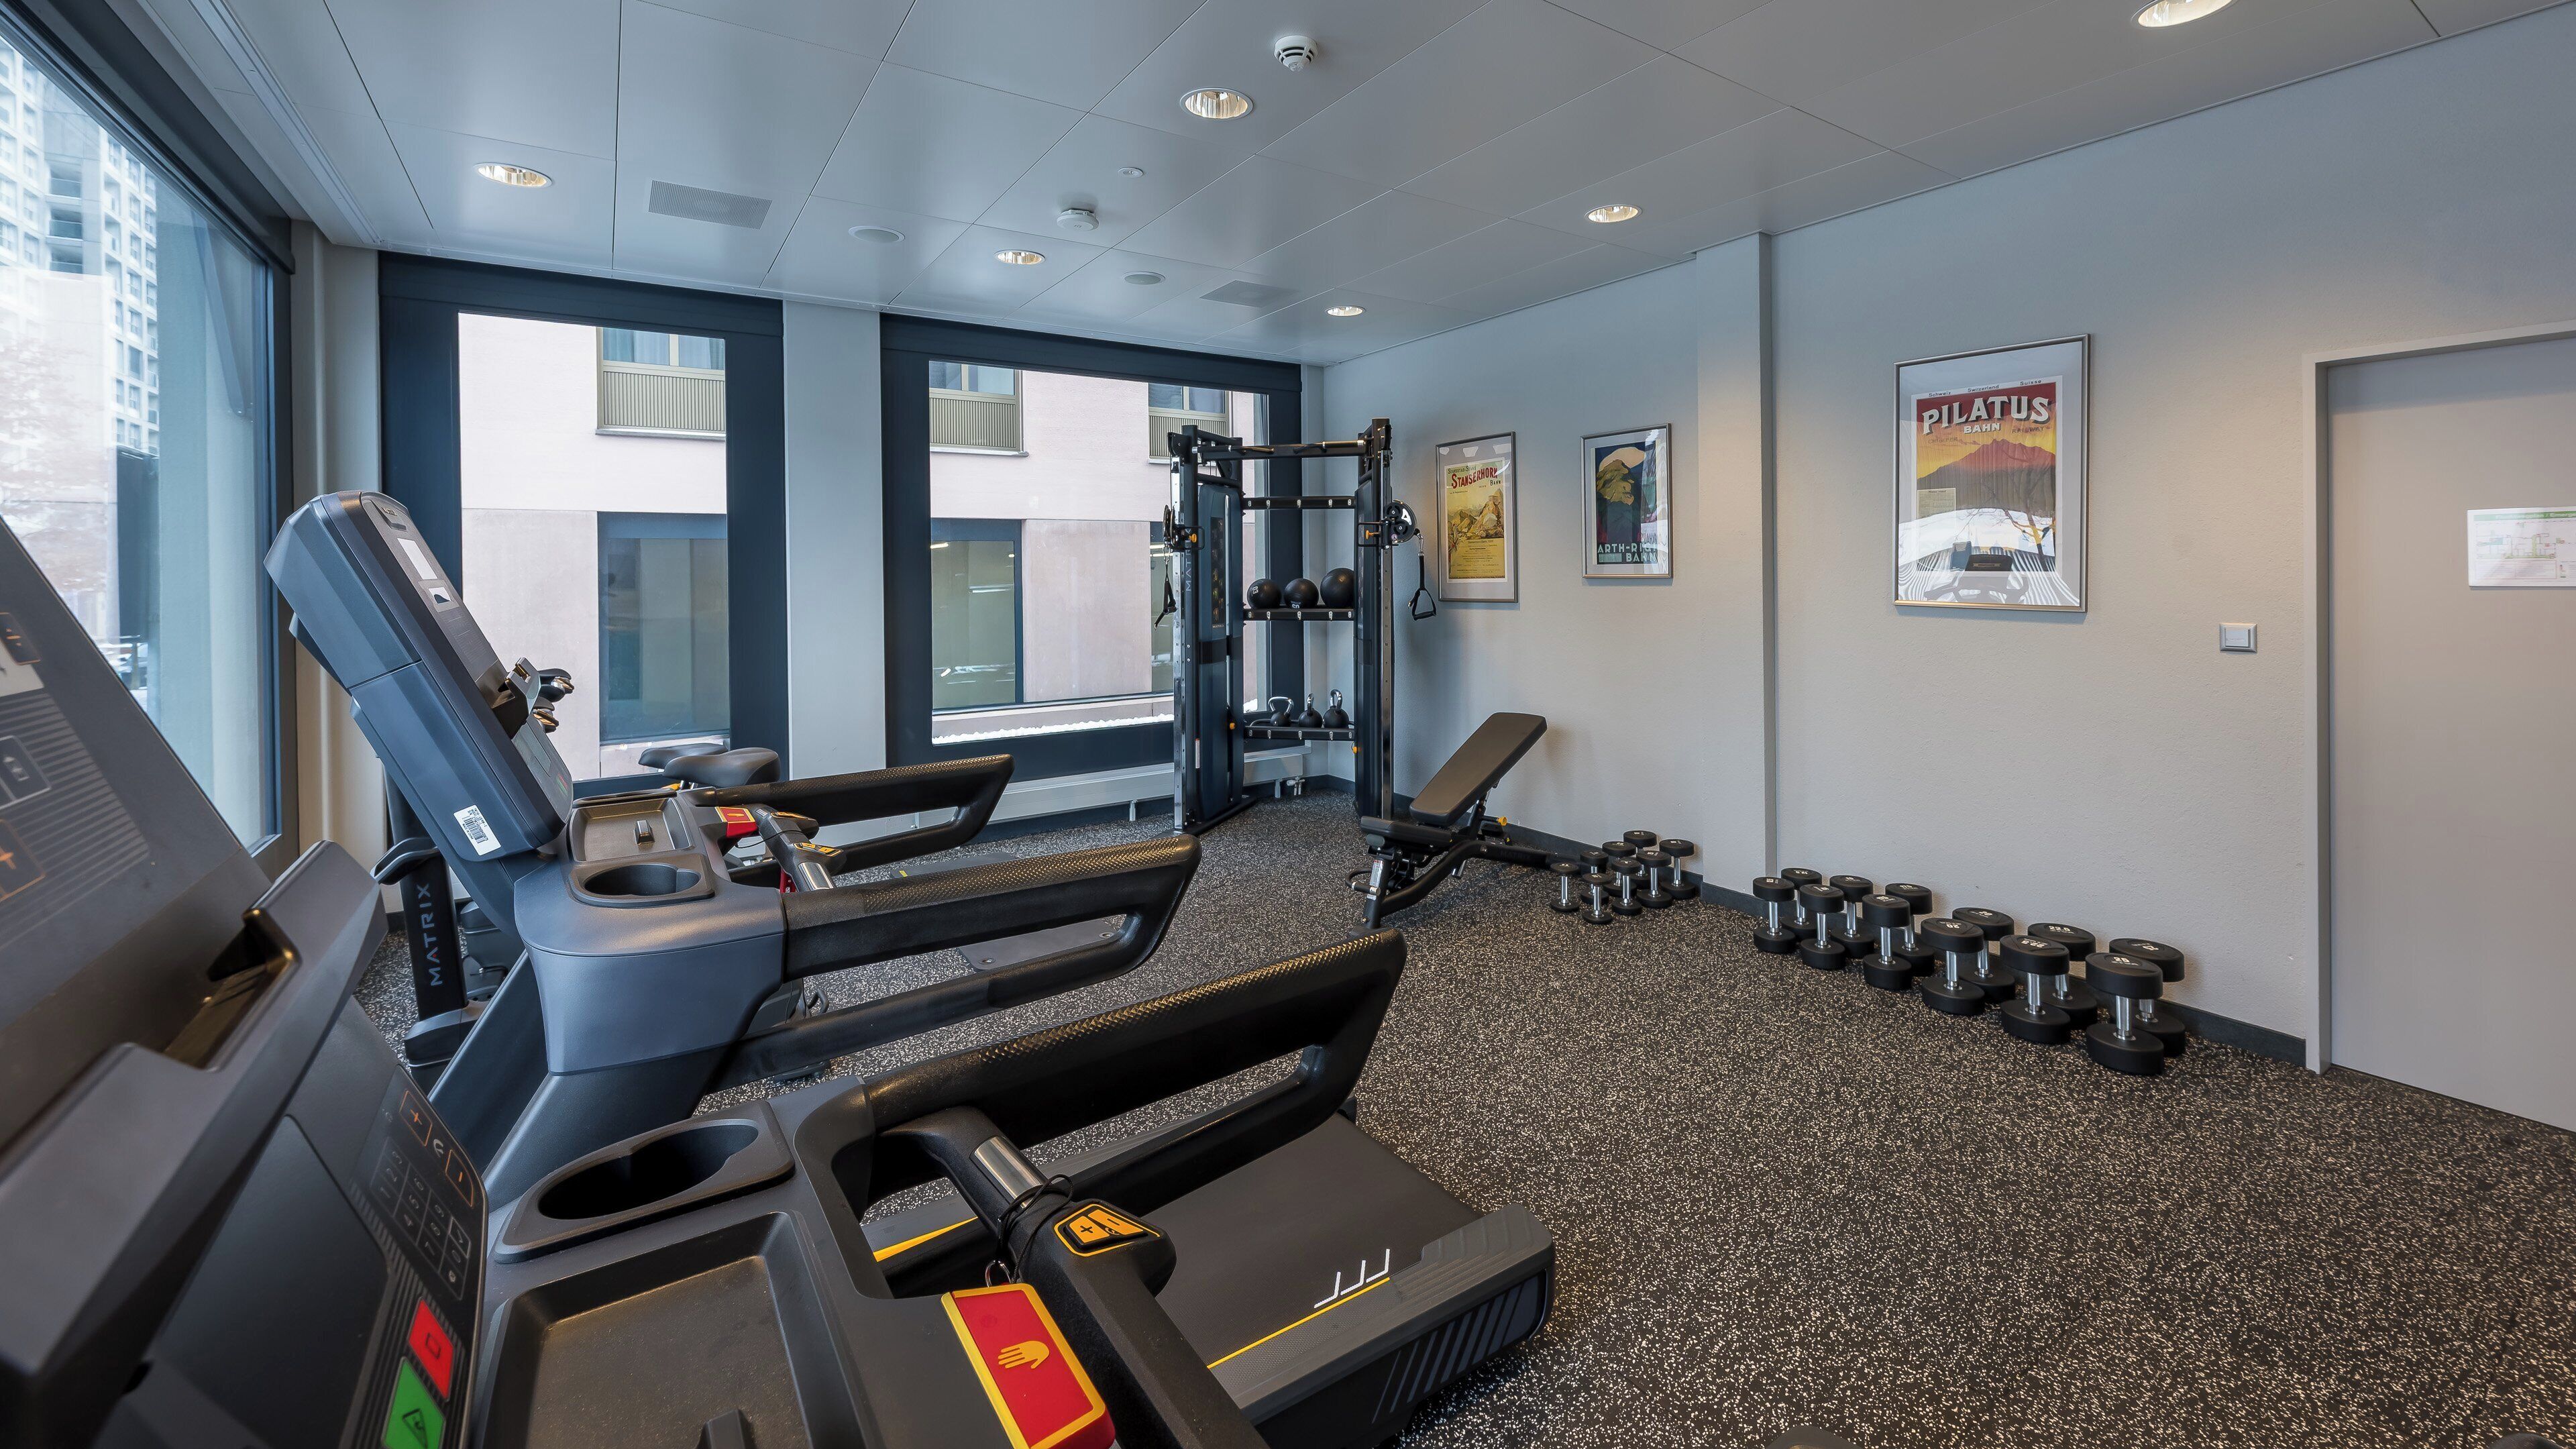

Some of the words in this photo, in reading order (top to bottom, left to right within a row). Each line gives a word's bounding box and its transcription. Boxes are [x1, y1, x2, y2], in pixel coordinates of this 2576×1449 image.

[1967, 384, 2000, 393] Switzerland
[1921, 395, 2050, 435] PILATUS
[1963, 423, 2002, 435] BAHN
[1451, 467, 1499, 489] STANSERHORN
[416, 883, 443, 986] MATRIX
